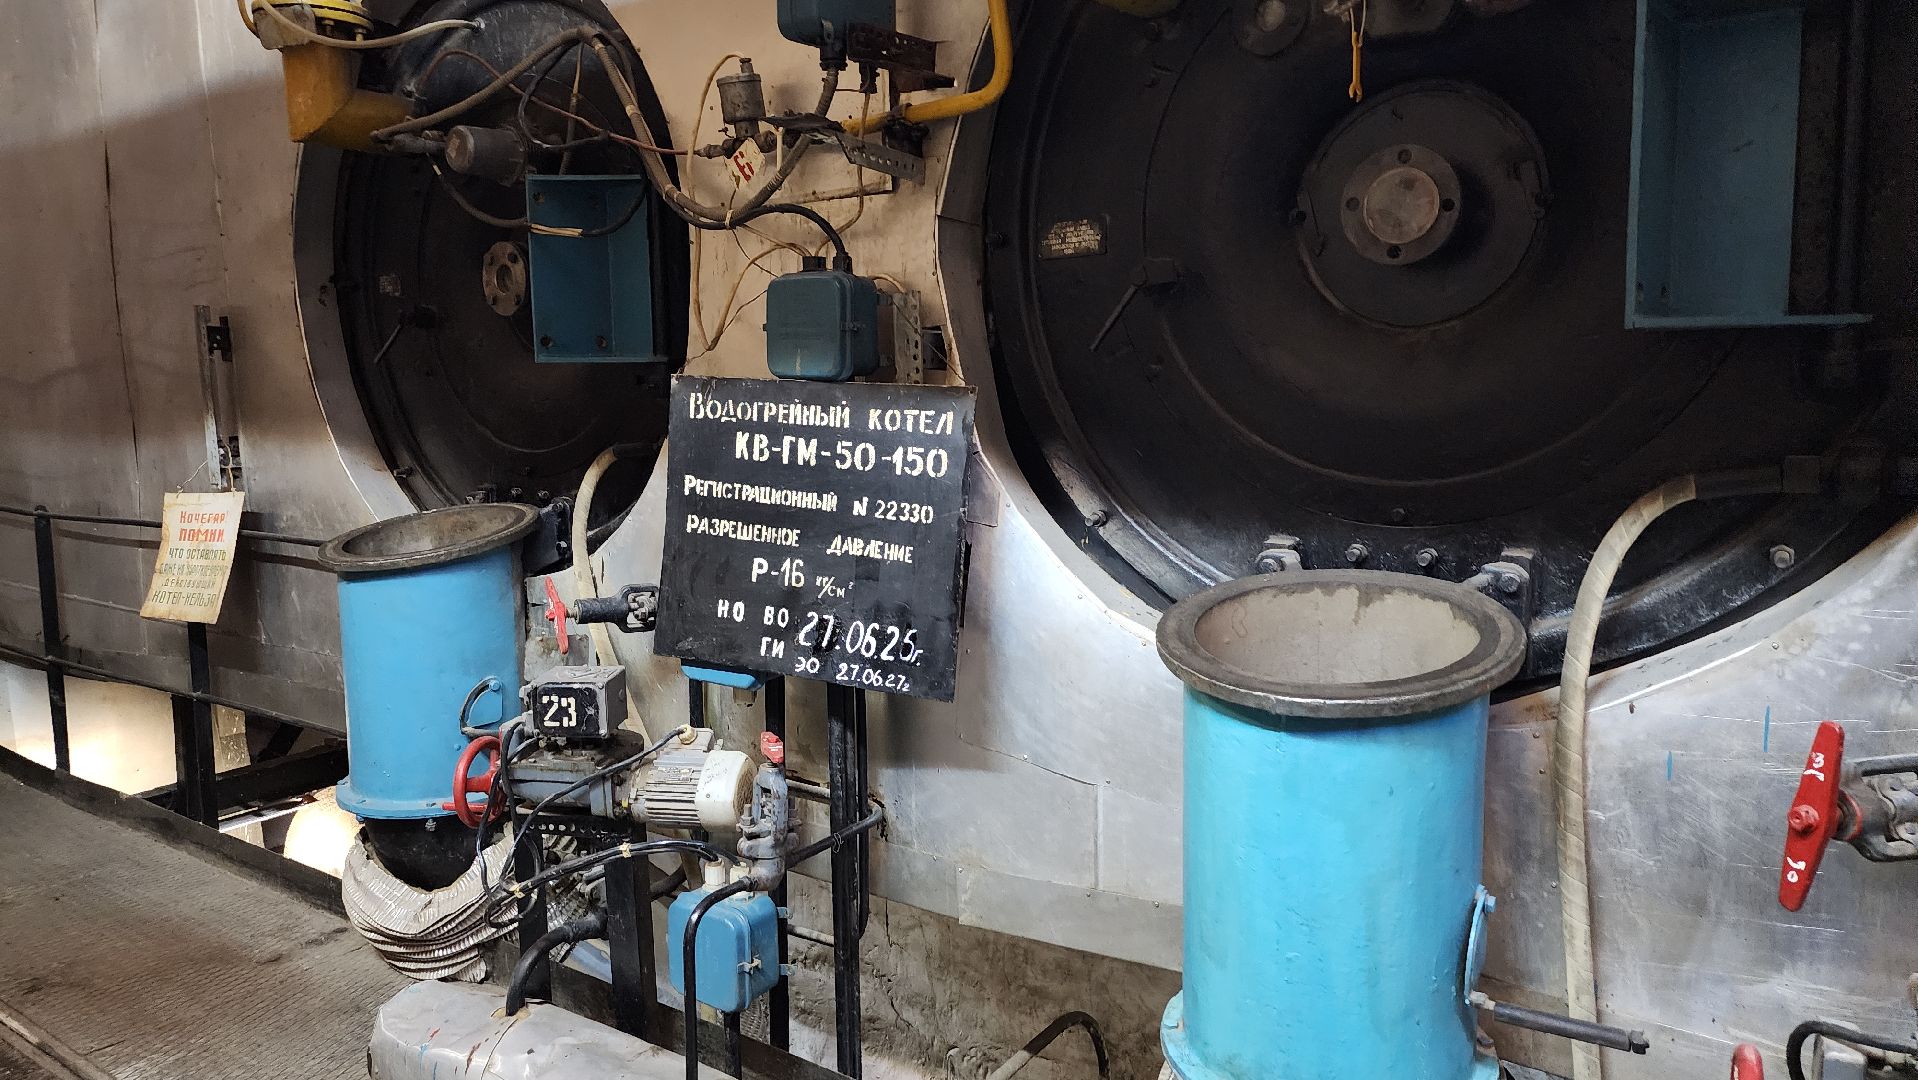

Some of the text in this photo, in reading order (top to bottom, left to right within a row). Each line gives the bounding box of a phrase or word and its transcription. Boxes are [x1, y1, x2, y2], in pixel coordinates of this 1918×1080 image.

[868, 408, 954, 435] КОТЕЛ
[735, 431, 948, 478] КВ-ГМ-50-150
[684, 474, 838, 512] РЕГИСТРАЦИОННЫЙ
[874, 499, 934, 524] 22330
[169, 547, 184, 559] ЧТО
[686, 514, 914, 564] РАЗРЕШЕННОЕ ДАВЛЕНИЕ
[751, 557, 805, 588] Р-16
[542, 694, 577, 728] 23
